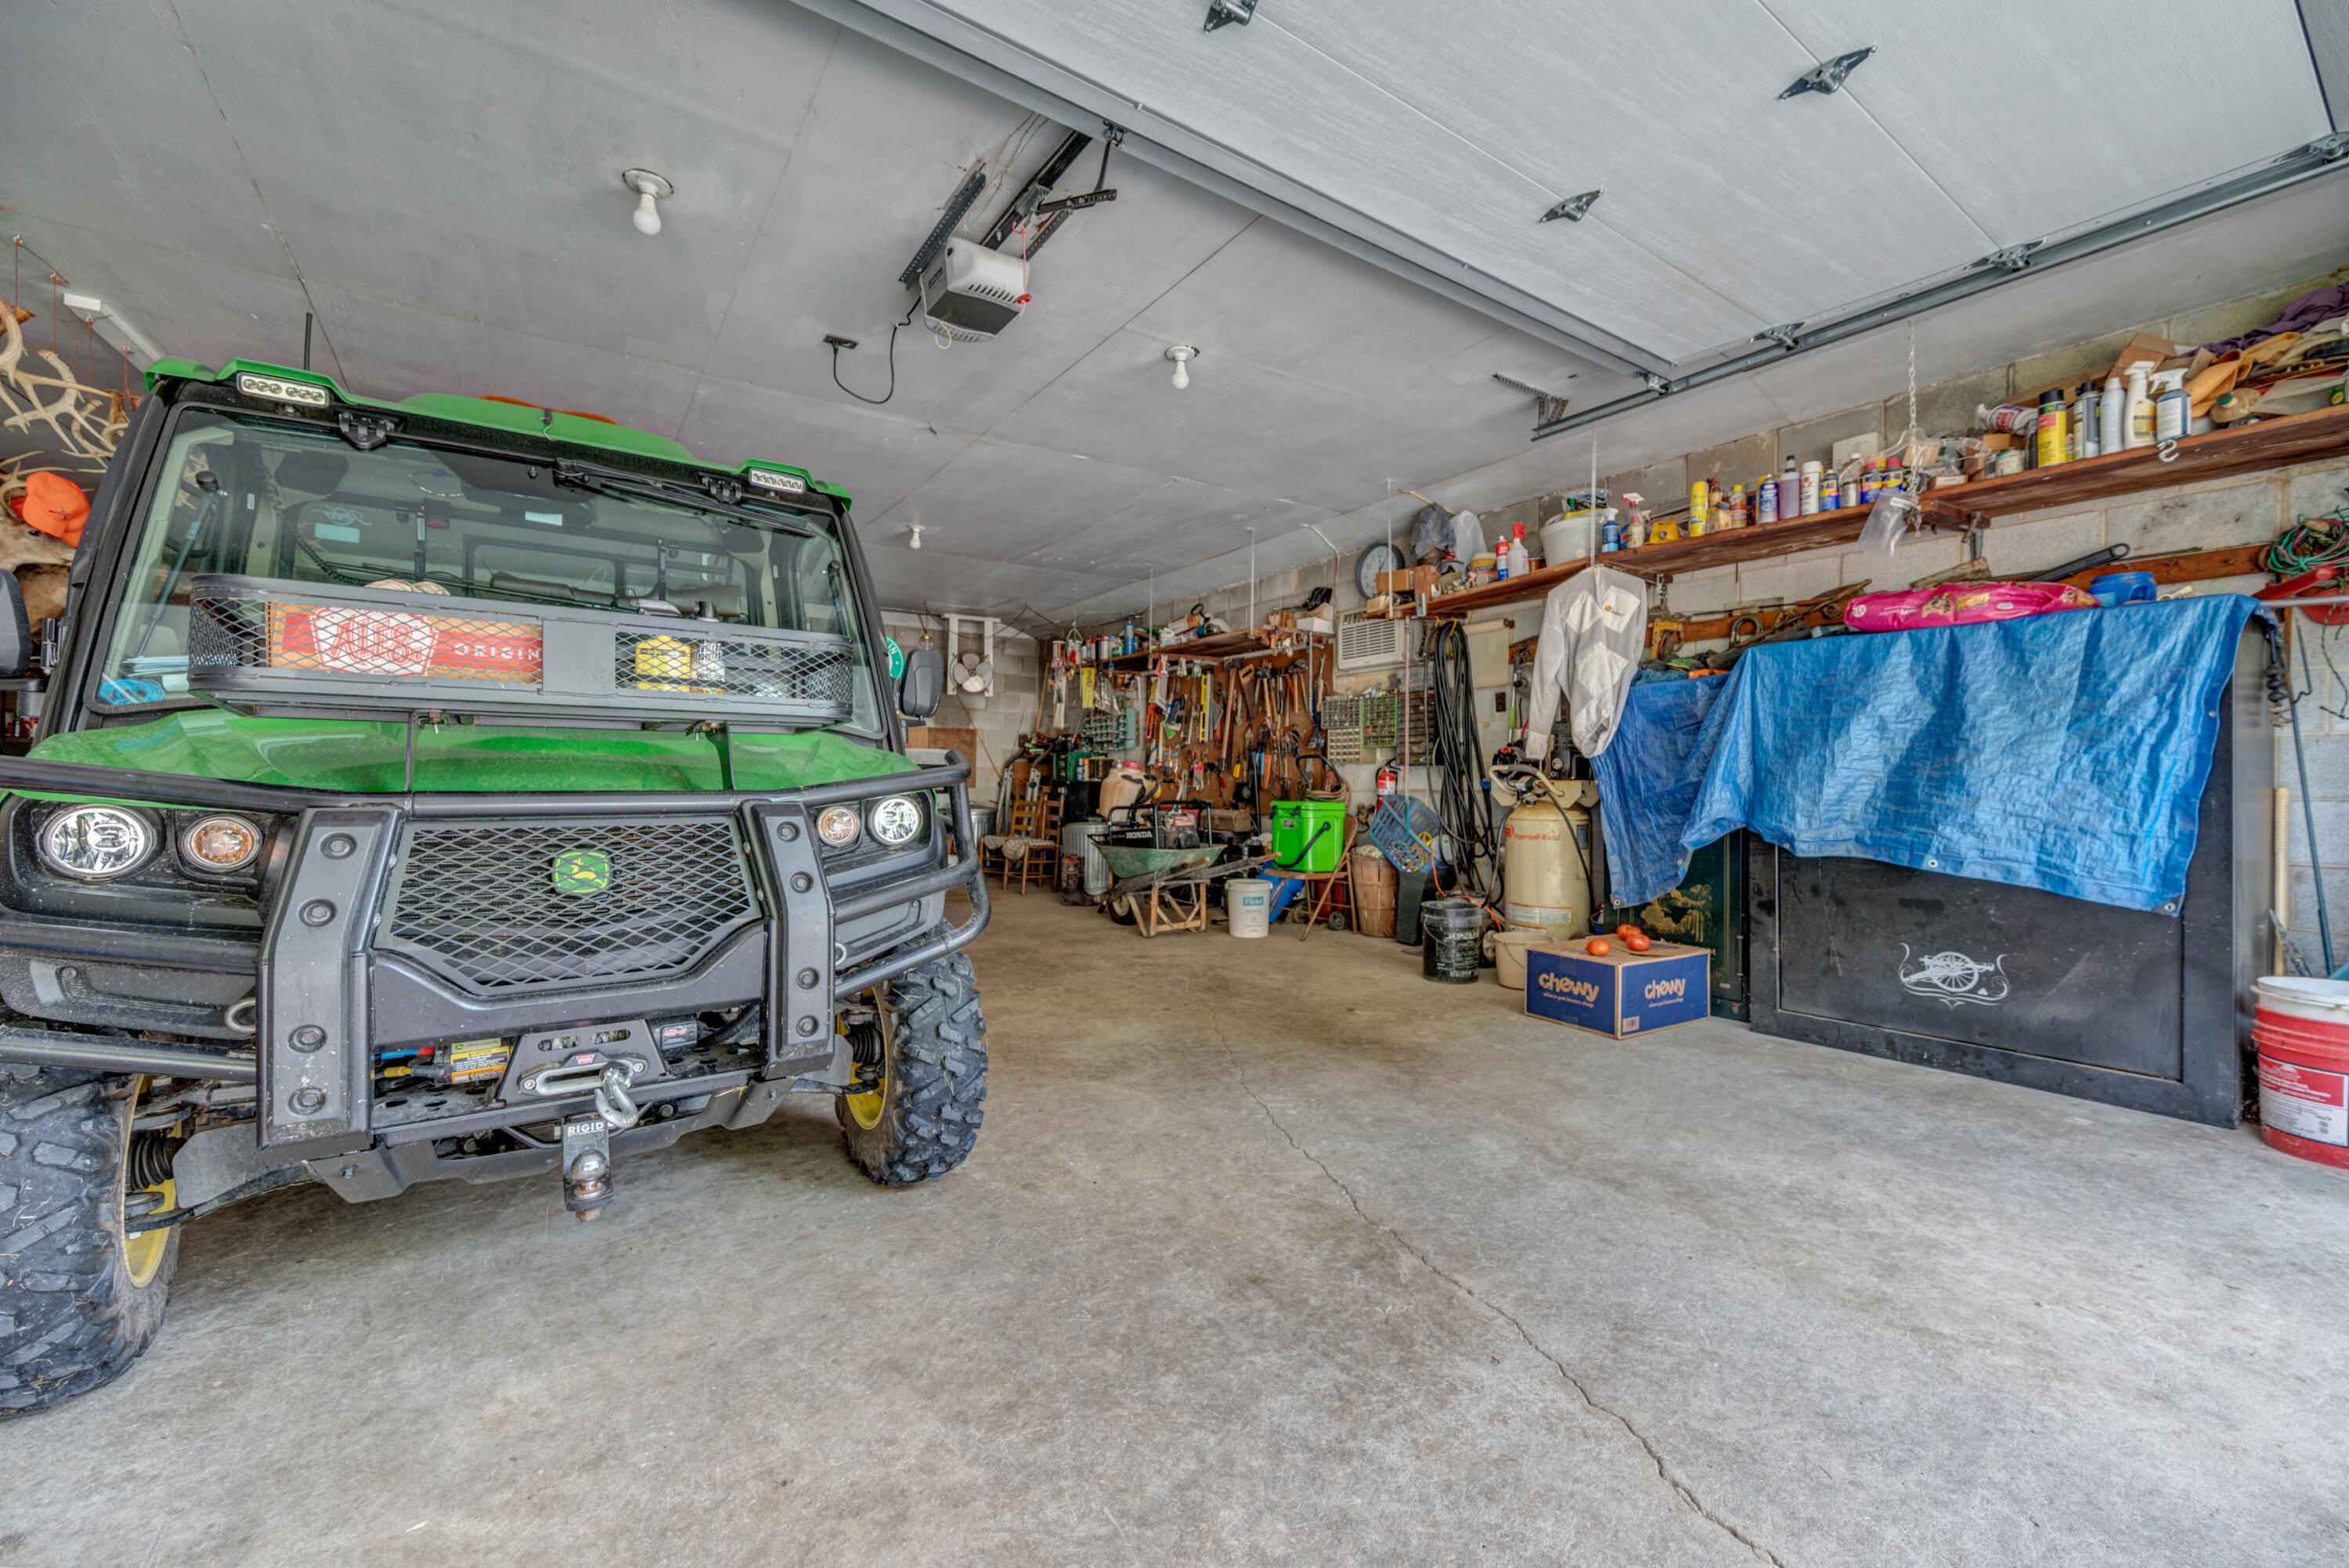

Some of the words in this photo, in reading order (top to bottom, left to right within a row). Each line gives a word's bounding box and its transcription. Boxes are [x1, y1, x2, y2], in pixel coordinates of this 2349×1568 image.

[1125, 830, 1153, 839] HONDA
[1514, 832, 1540, 841] Ingersoll
[1541, 833, 1561, 842] Rand
[1539, 971, 1600, 1002] chewy
[1644, 979, 1686, 1000] chewy
[567, 1121, 604, 1137] RIGID
